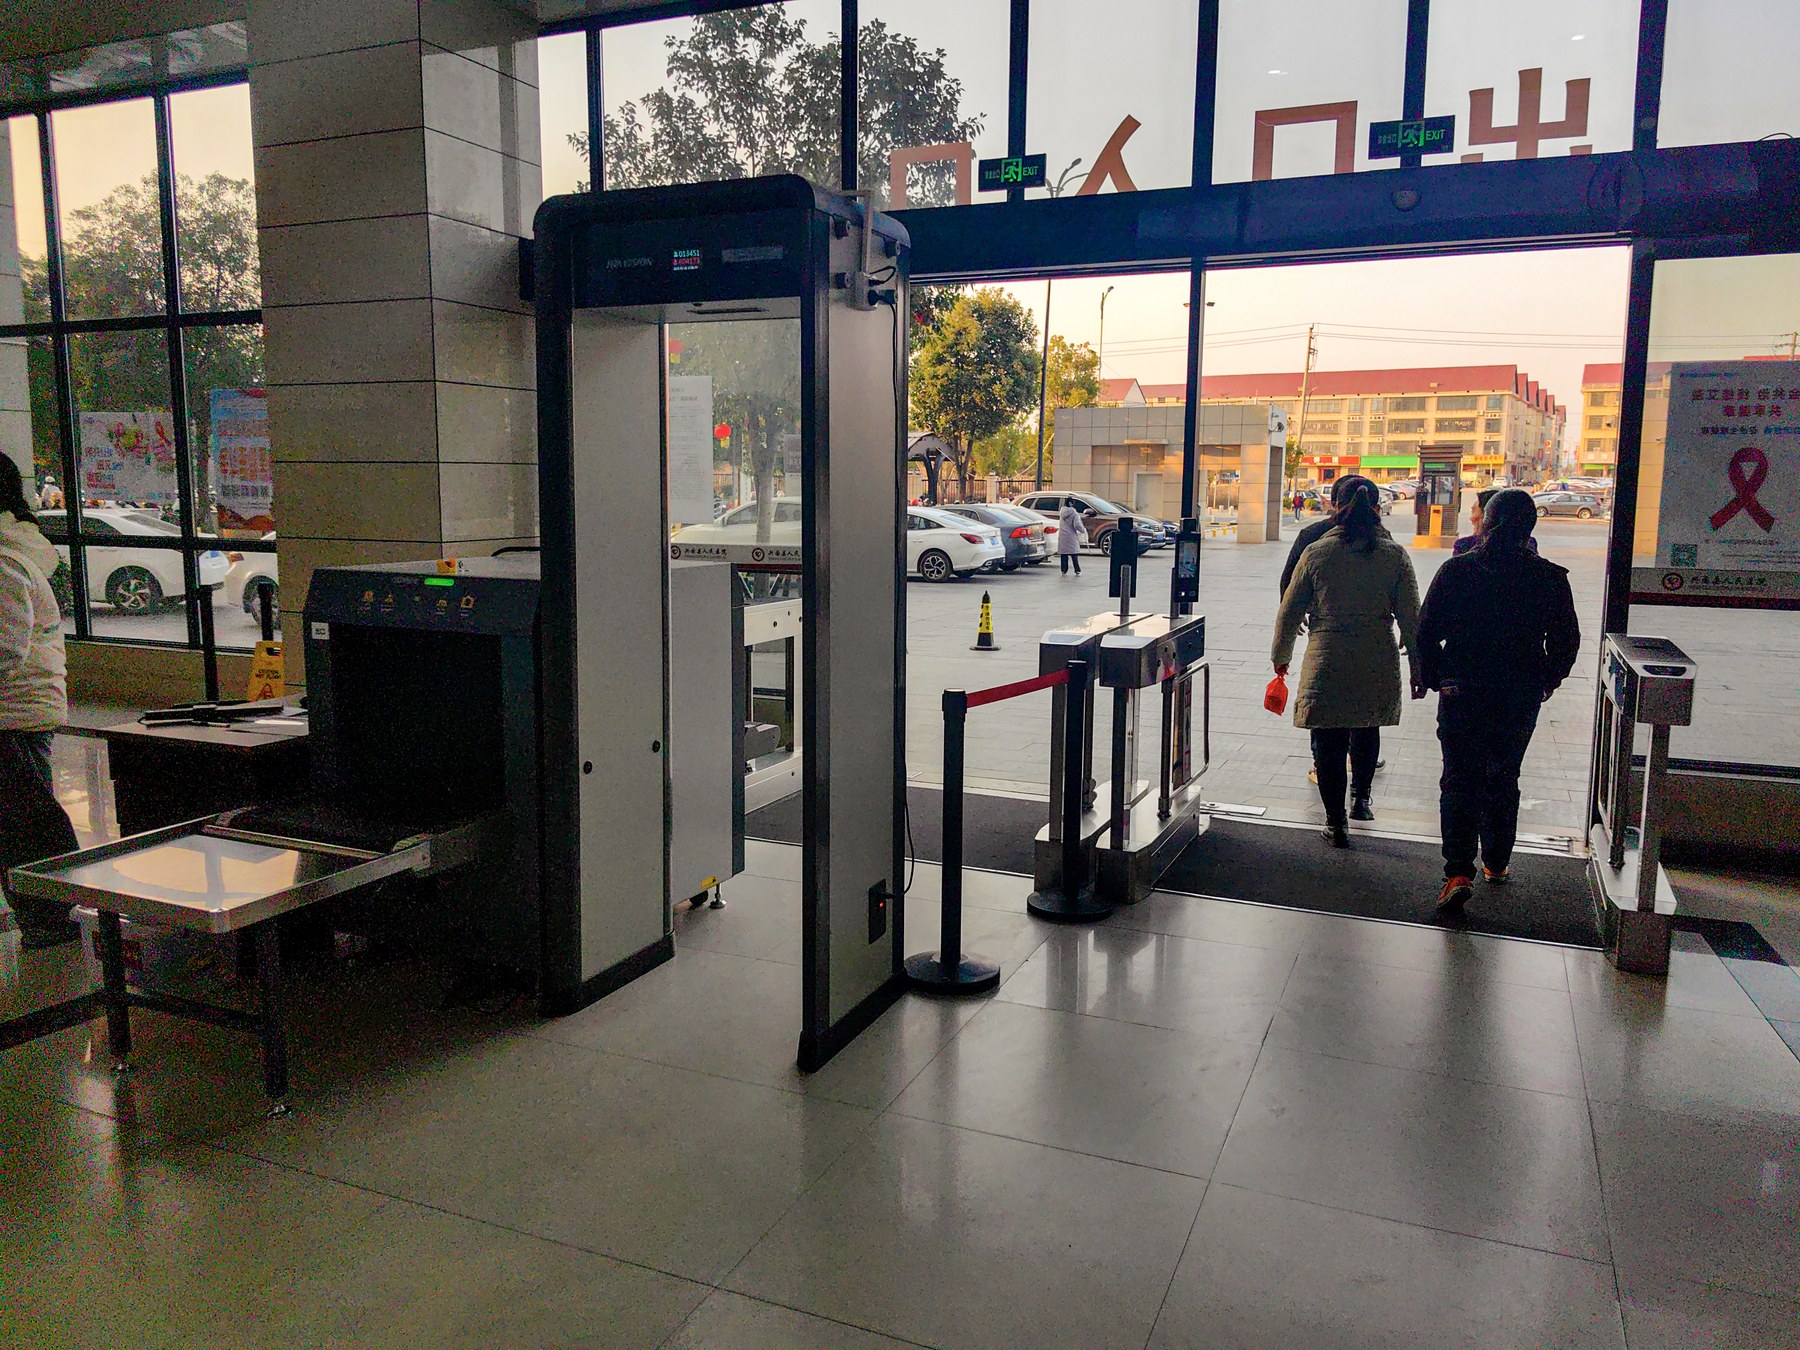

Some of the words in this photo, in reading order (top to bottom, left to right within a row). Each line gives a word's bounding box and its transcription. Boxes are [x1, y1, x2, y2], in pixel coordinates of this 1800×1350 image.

[1425, 129, 1445, 141] EXIT
[1023, 166, 1039, 176] EXIT
[679, 249, 700, 258] 013451
